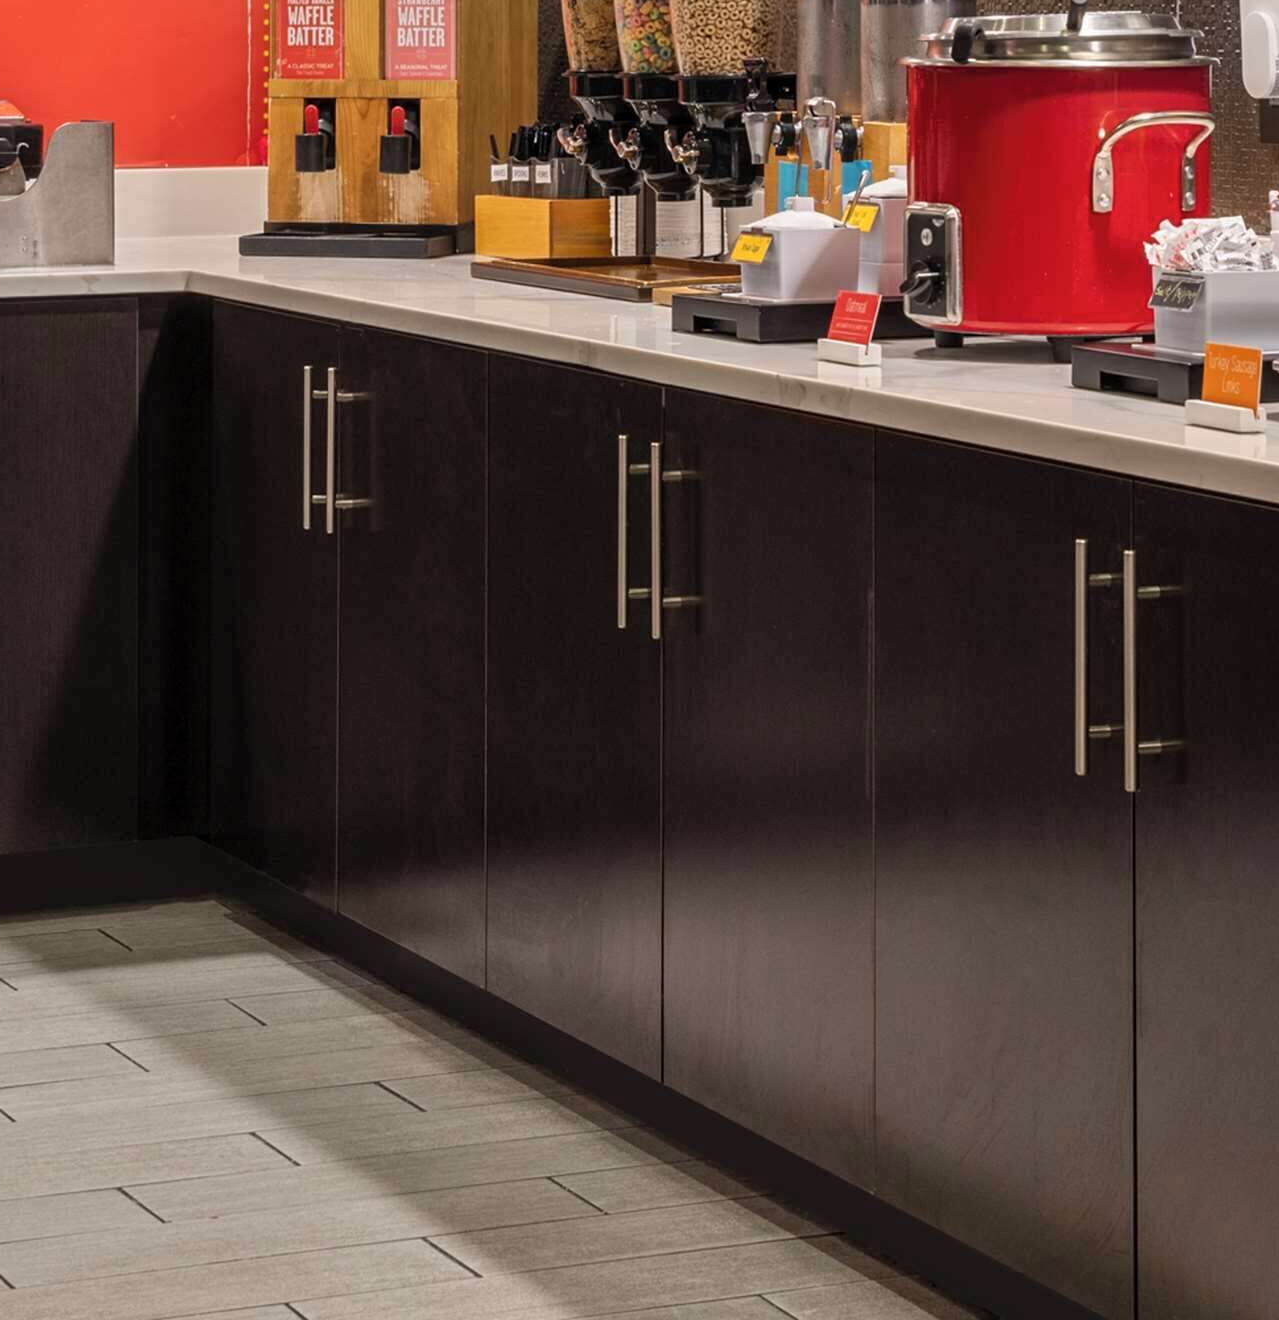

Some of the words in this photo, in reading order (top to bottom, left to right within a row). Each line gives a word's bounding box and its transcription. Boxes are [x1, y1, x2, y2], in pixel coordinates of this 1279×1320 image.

[287, 6, 335, 26] WAFFLE
[397, 6, 446, 26] WAFFLE
[287, 26, 334, 47] BATTER
[397, 27, 446, 48] BATTER
[1208, 351, 1231, 375] Turkey
[1222, 375, 1241, 394] Links
